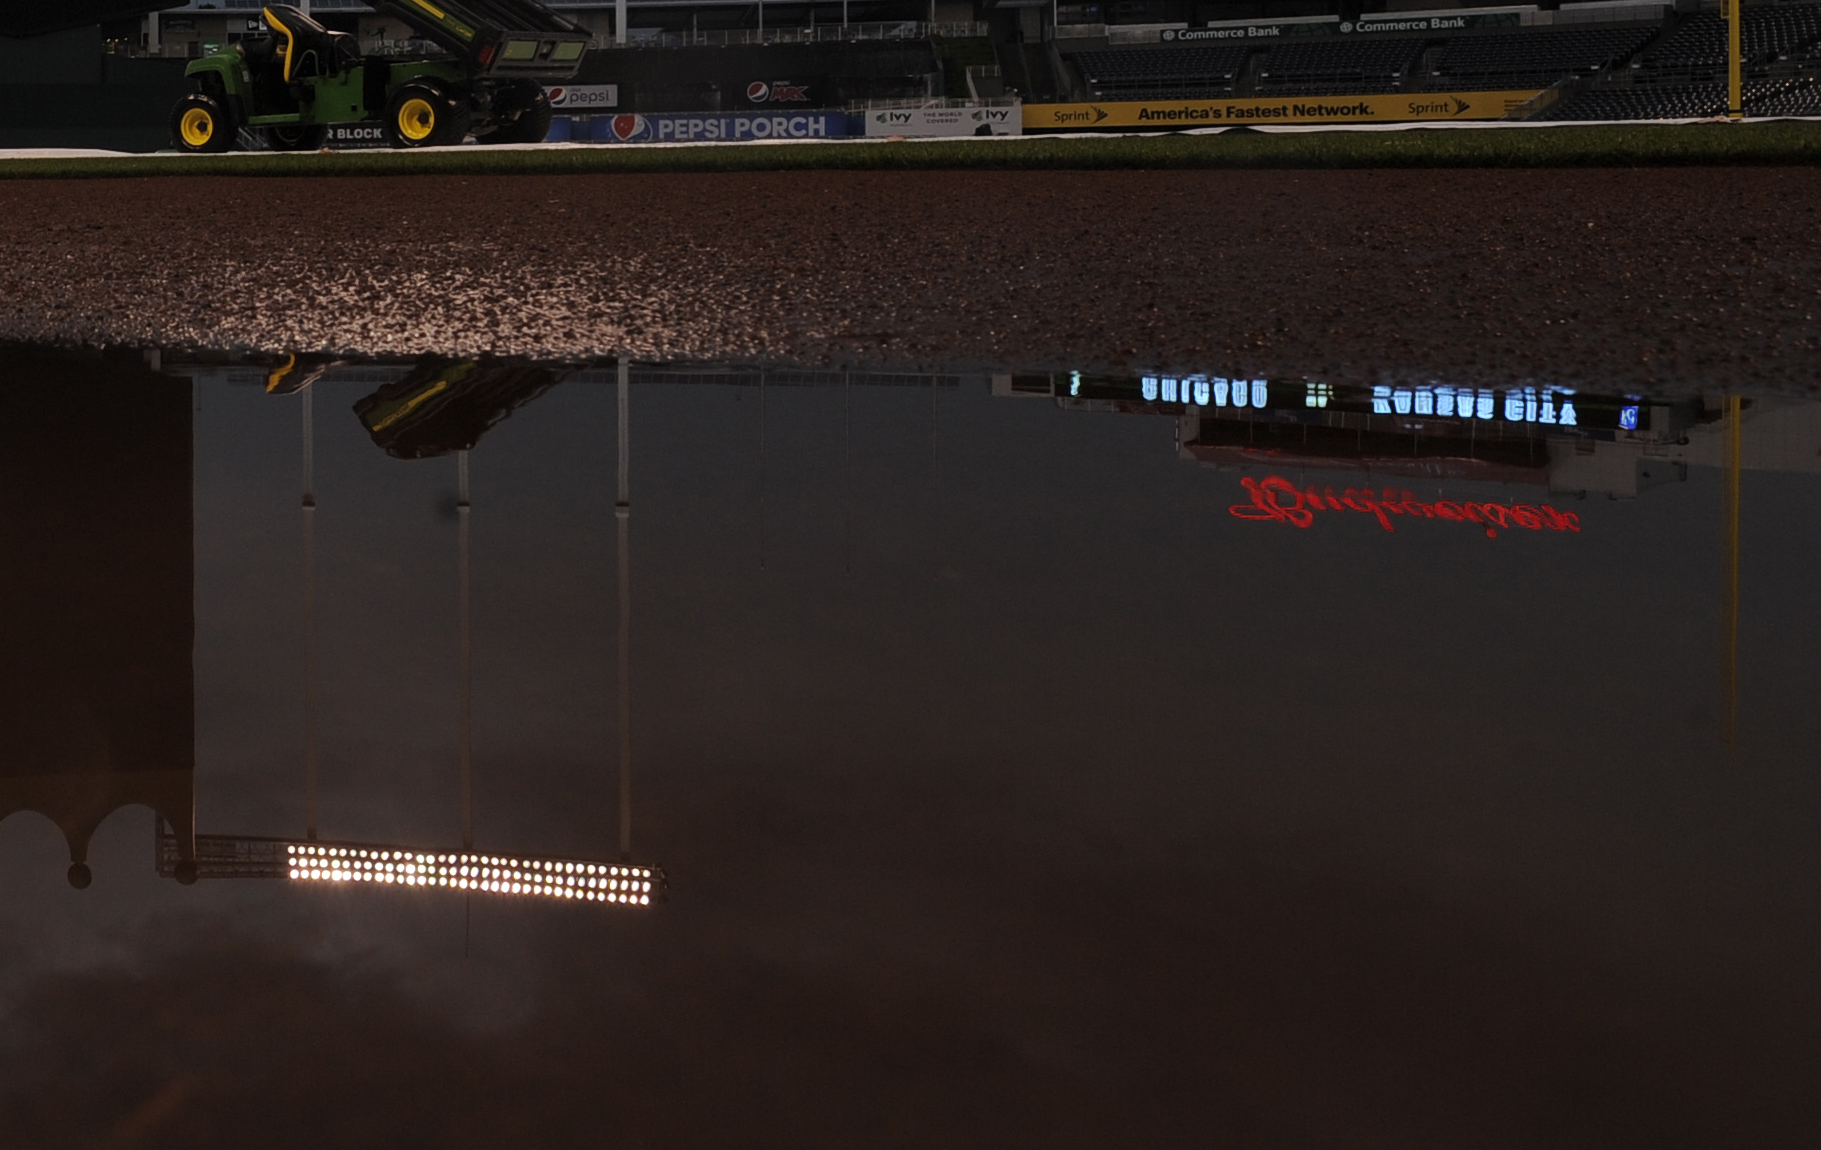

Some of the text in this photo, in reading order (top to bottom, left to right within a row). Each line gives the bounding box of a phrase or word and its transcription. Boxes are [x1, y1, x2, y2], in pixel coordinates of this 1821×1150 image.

[1356, 16, 1466, 33] Commerce Bank
[1178, 26, 1280, 41] Commerce Bank
[569, 90, 610, 104] pepsi
[985, 109, 1009, 121] Ivy
[1138, 102, 1375, 121] America's Fastest Network.
[1408, 102, 1449, 116] Sprint
[889, 111, 912, 123] Ivy
[1054, 111, 1090, 124] Sprint
[337, 128, 384, 140] BLOCK
[658, 116, 826, 139] PEPSI PORCH
